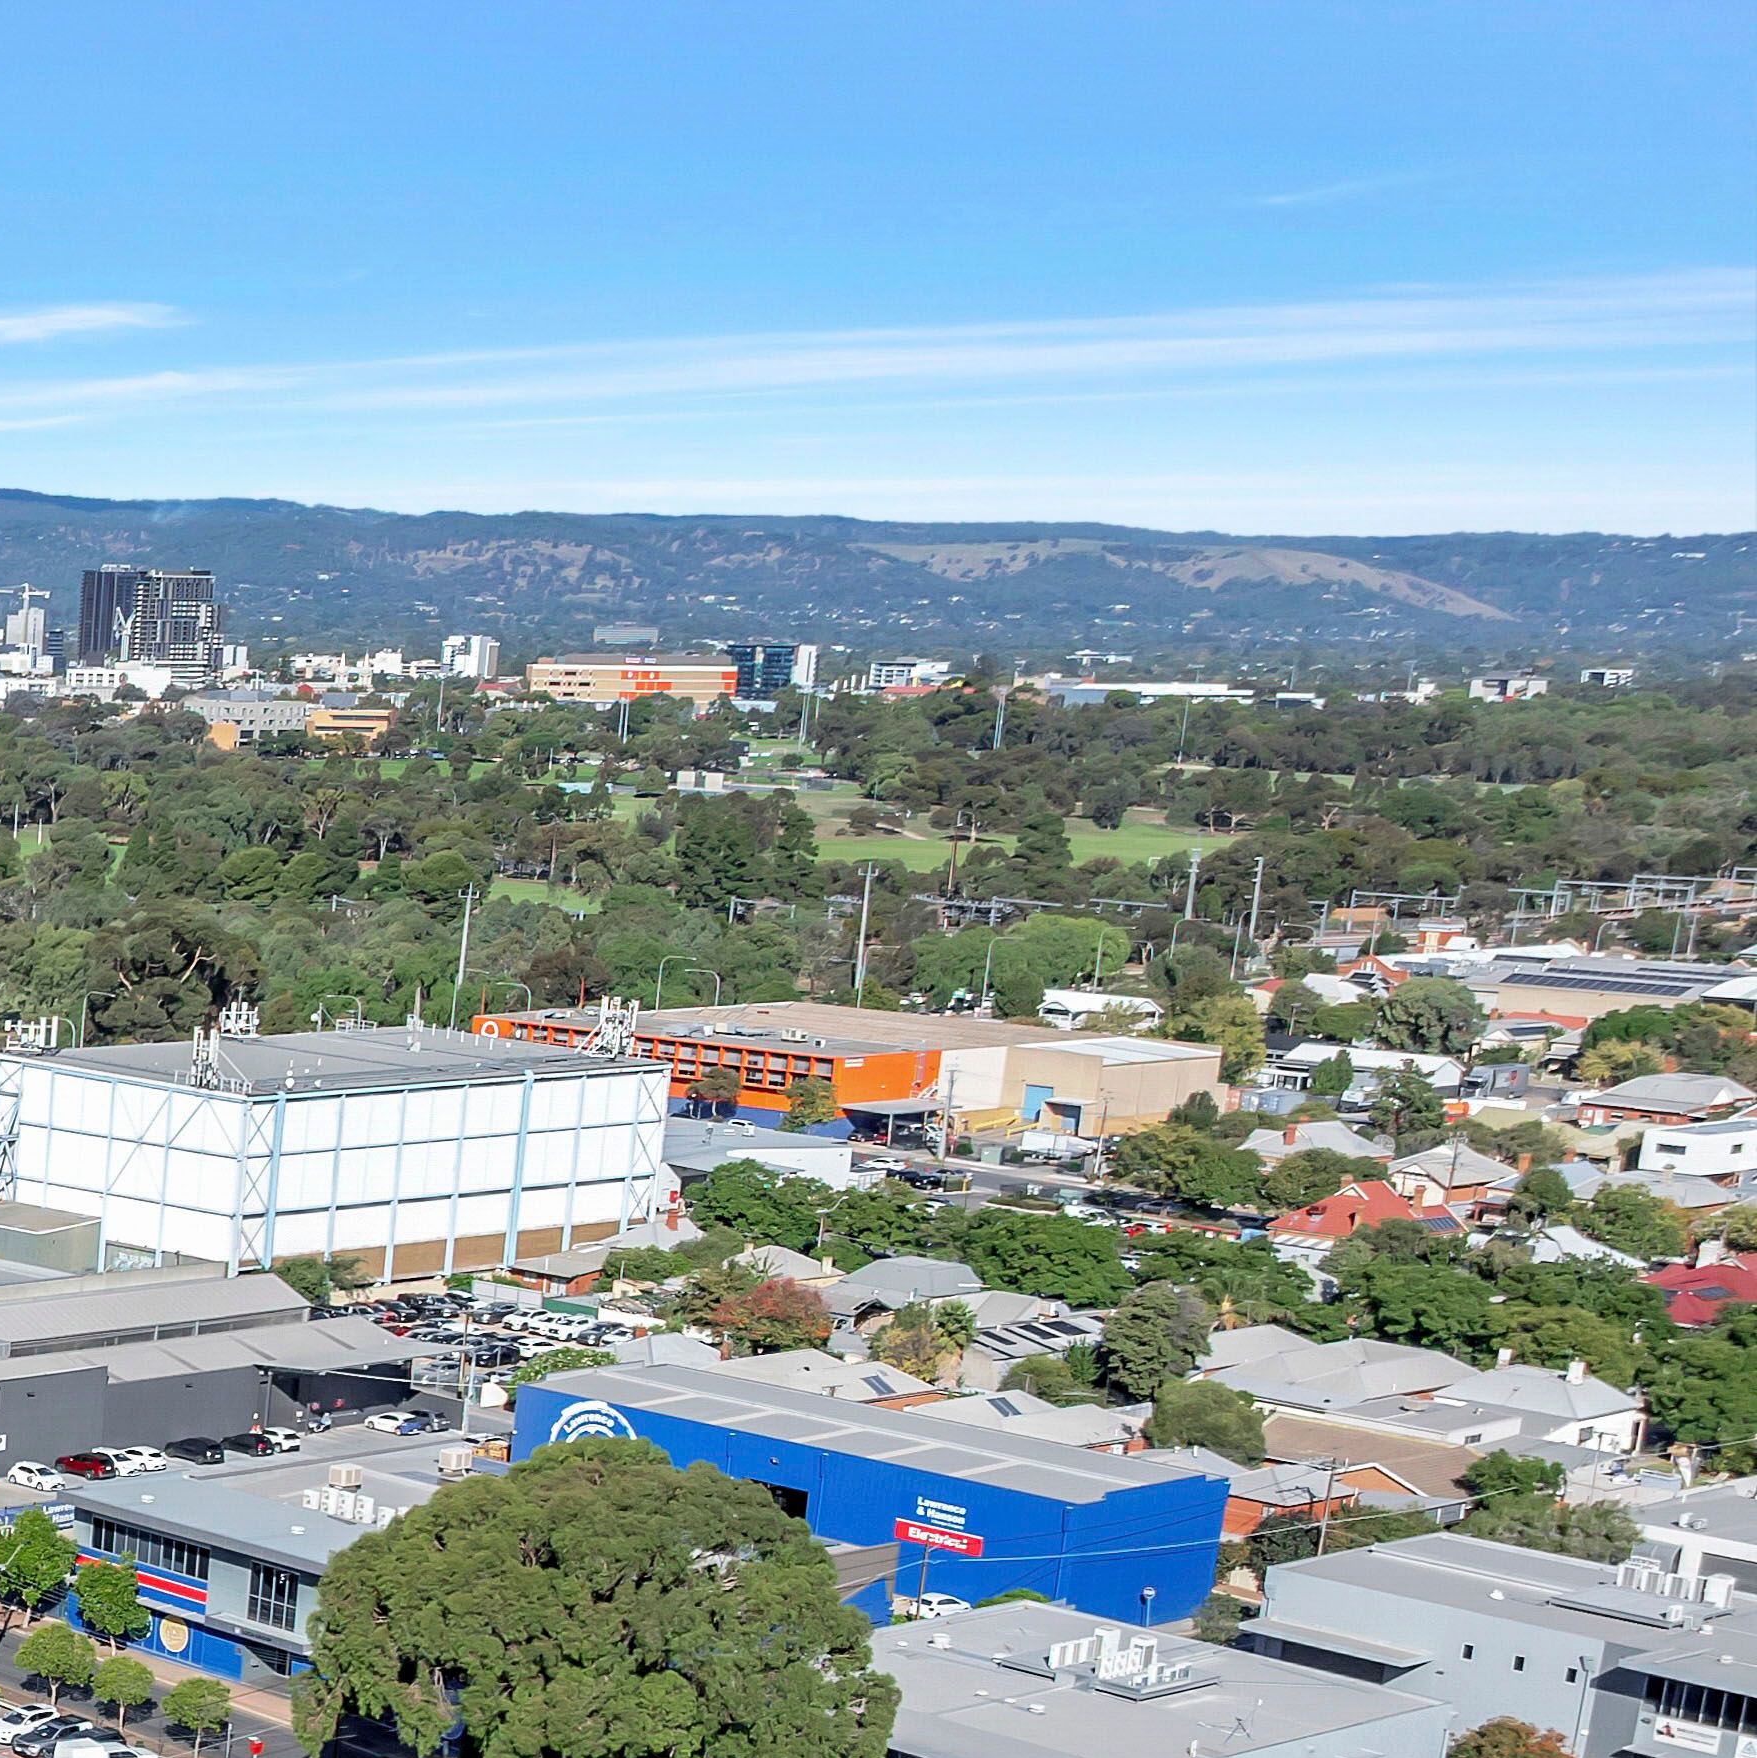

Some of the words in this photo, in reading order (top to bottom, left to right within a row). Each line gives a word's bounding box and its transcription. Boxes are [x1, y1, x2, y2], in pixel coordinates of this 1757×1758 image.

[915, 1505, 925, 1516] &
[926, 1507, 966, 1524] Hanson
[916, 1495, 967, 1515] Lawrence
